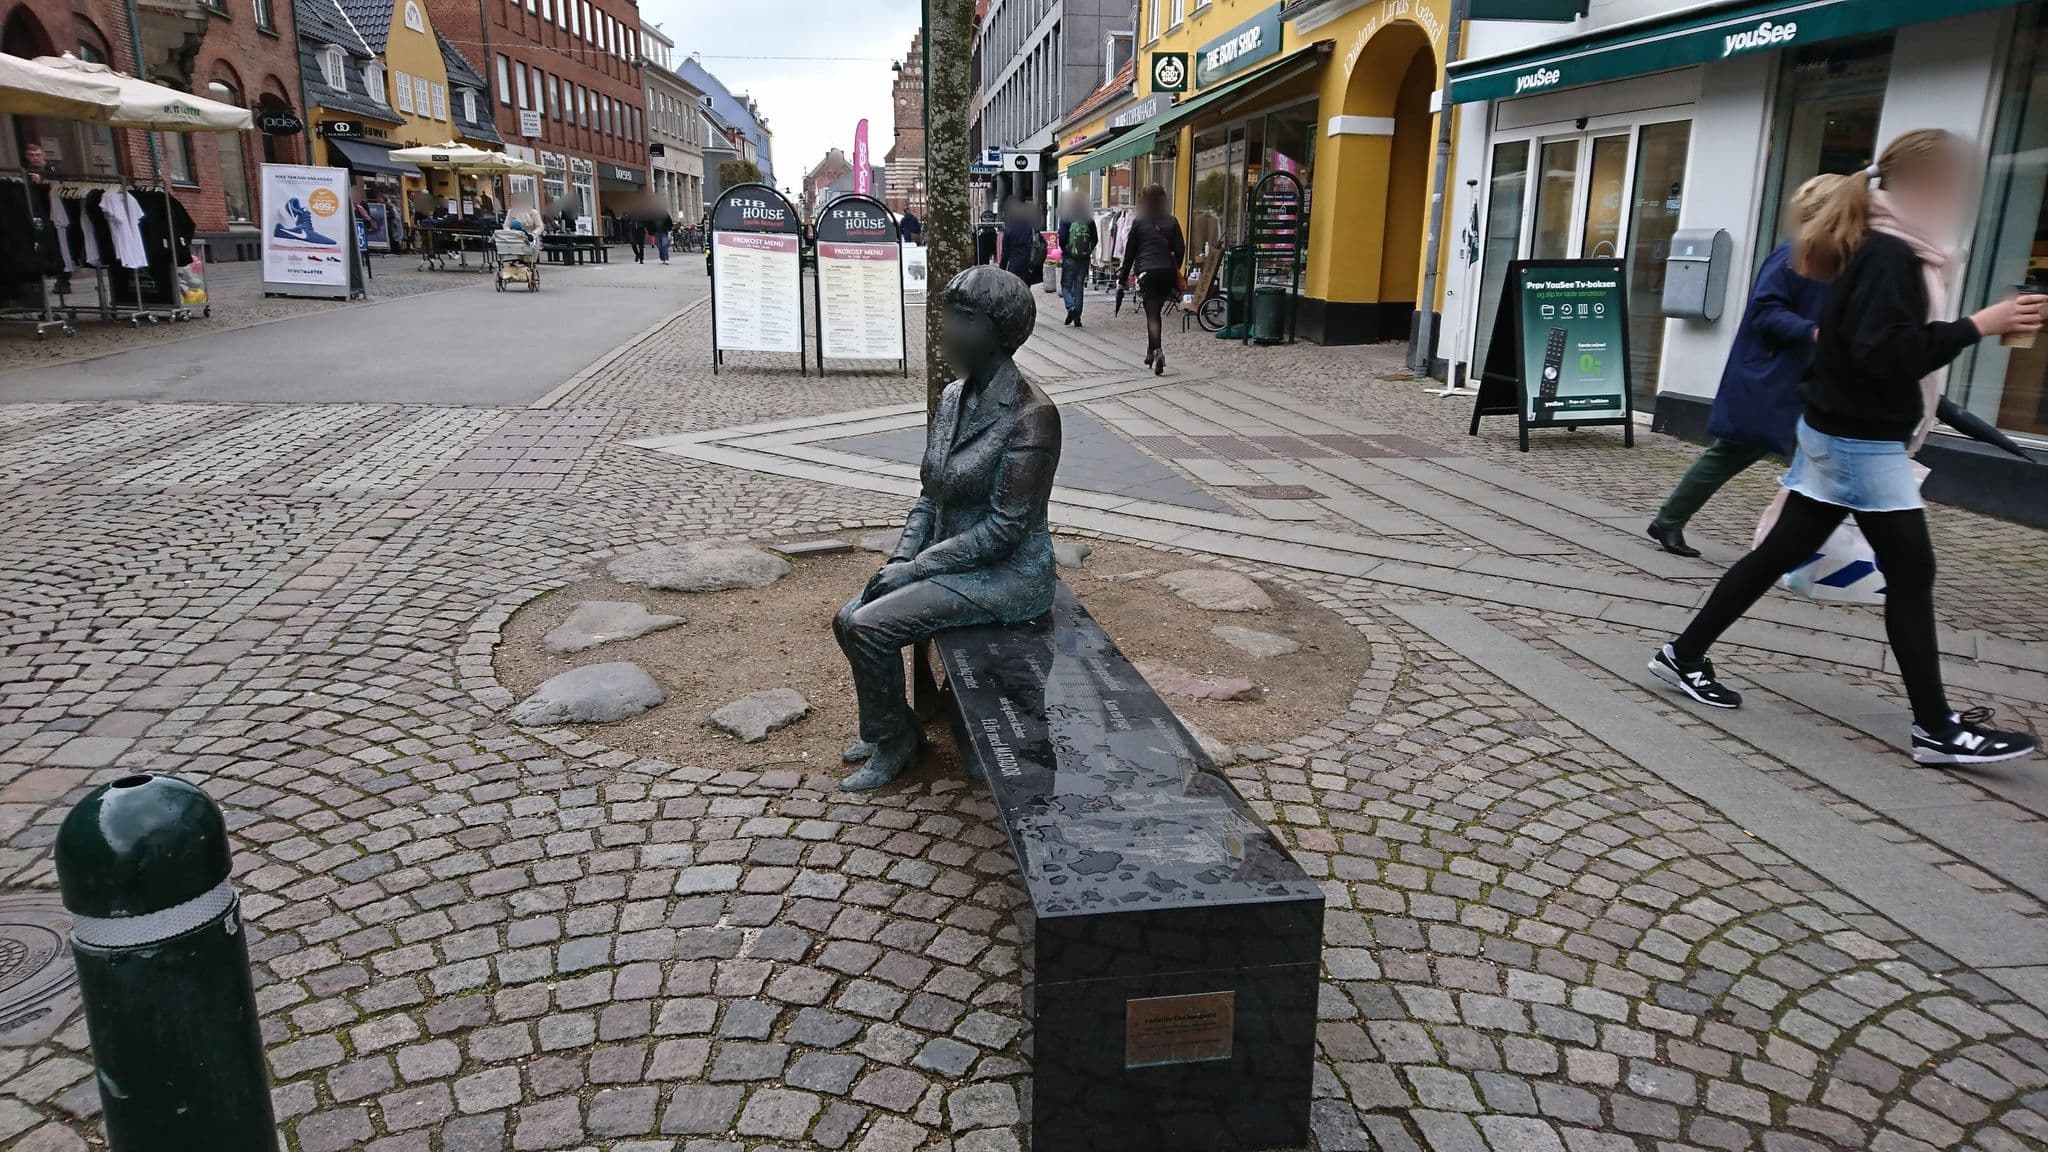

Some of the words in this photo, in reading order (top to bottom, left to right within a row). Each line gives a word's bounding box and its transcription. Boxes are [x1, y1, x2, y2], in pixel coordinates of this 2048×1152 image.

[1723, 21, 1797, 58] youSee
[1206, 47, 1220, 71] THE
[1219, 36, 1239, 66] BODY
[1514, 68, 1560, 94] youSee
[730, 198, 766, 207] RIB
[742, 207, 785, 220] HOUSE
[832, 210, 867, 218] RIB
[845, 217, 886, 230] HOUSE
[733, 236, 763, 245] FROKOST
[764, 239, 784, 247] MENU
[1545, 281, 1574, 289] YouSee
[992, 747, 1021, 777] MATADOR
